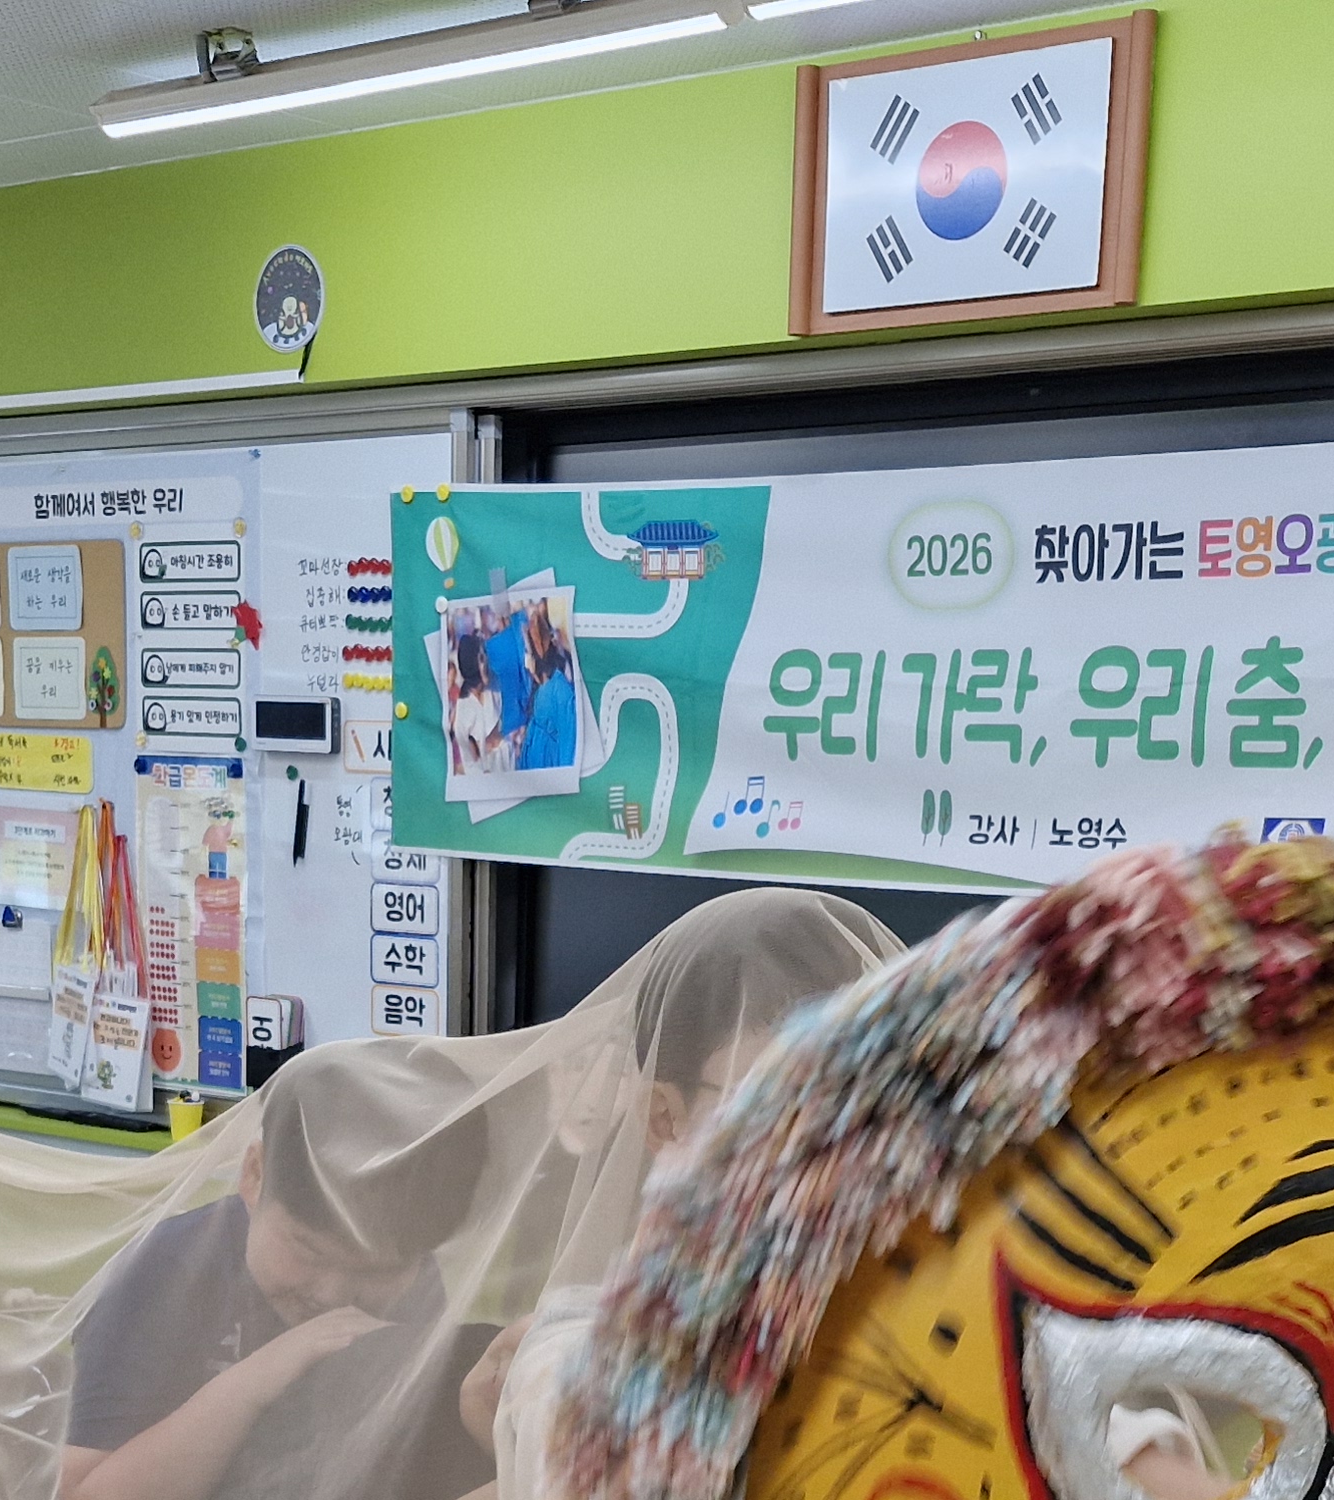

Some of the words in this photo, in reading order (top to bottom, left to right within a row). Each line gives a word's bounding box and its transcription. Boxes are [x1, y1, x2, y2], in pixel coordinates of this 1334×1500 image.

[34, 491, 95, 520] 함께여서
[100, 488, 147, 517] 행복한
[153, 488, 183, 514] 우리
[170, 553, 205, 570] 아침시간
[207, 553, 234, 569] 조용히
[906, 532, 993, 578] 2026
[1034, 520, 1185, 584] 찾아가는
[20, 567, 42, 584] 새로운
[47, 565, 72, 584] 생각을
[50, 594, 67, 609] 우리
[171, 604, 180, 621] 손
[182, 604, 200, 621] 들고
[203, 604, 234, 621] 말하기
[40, 683, 57, 699] 우리
[763, 647, 887, 763] 우리
[901, 645, 1047, 767] 가락,
[1069, 645, 1214, 768] 우리
[1225, 635, 1324, 770] 춤,
[171, 709, 185, 724] 용기
[967, 814, 1020, 847] 강사
[1048, 816, 1128, 850] 노영수
[384, 891, 425, 924] 영어
[383, 943, 426, 975] 수학
[384, 994, 425, 1028] 음악
